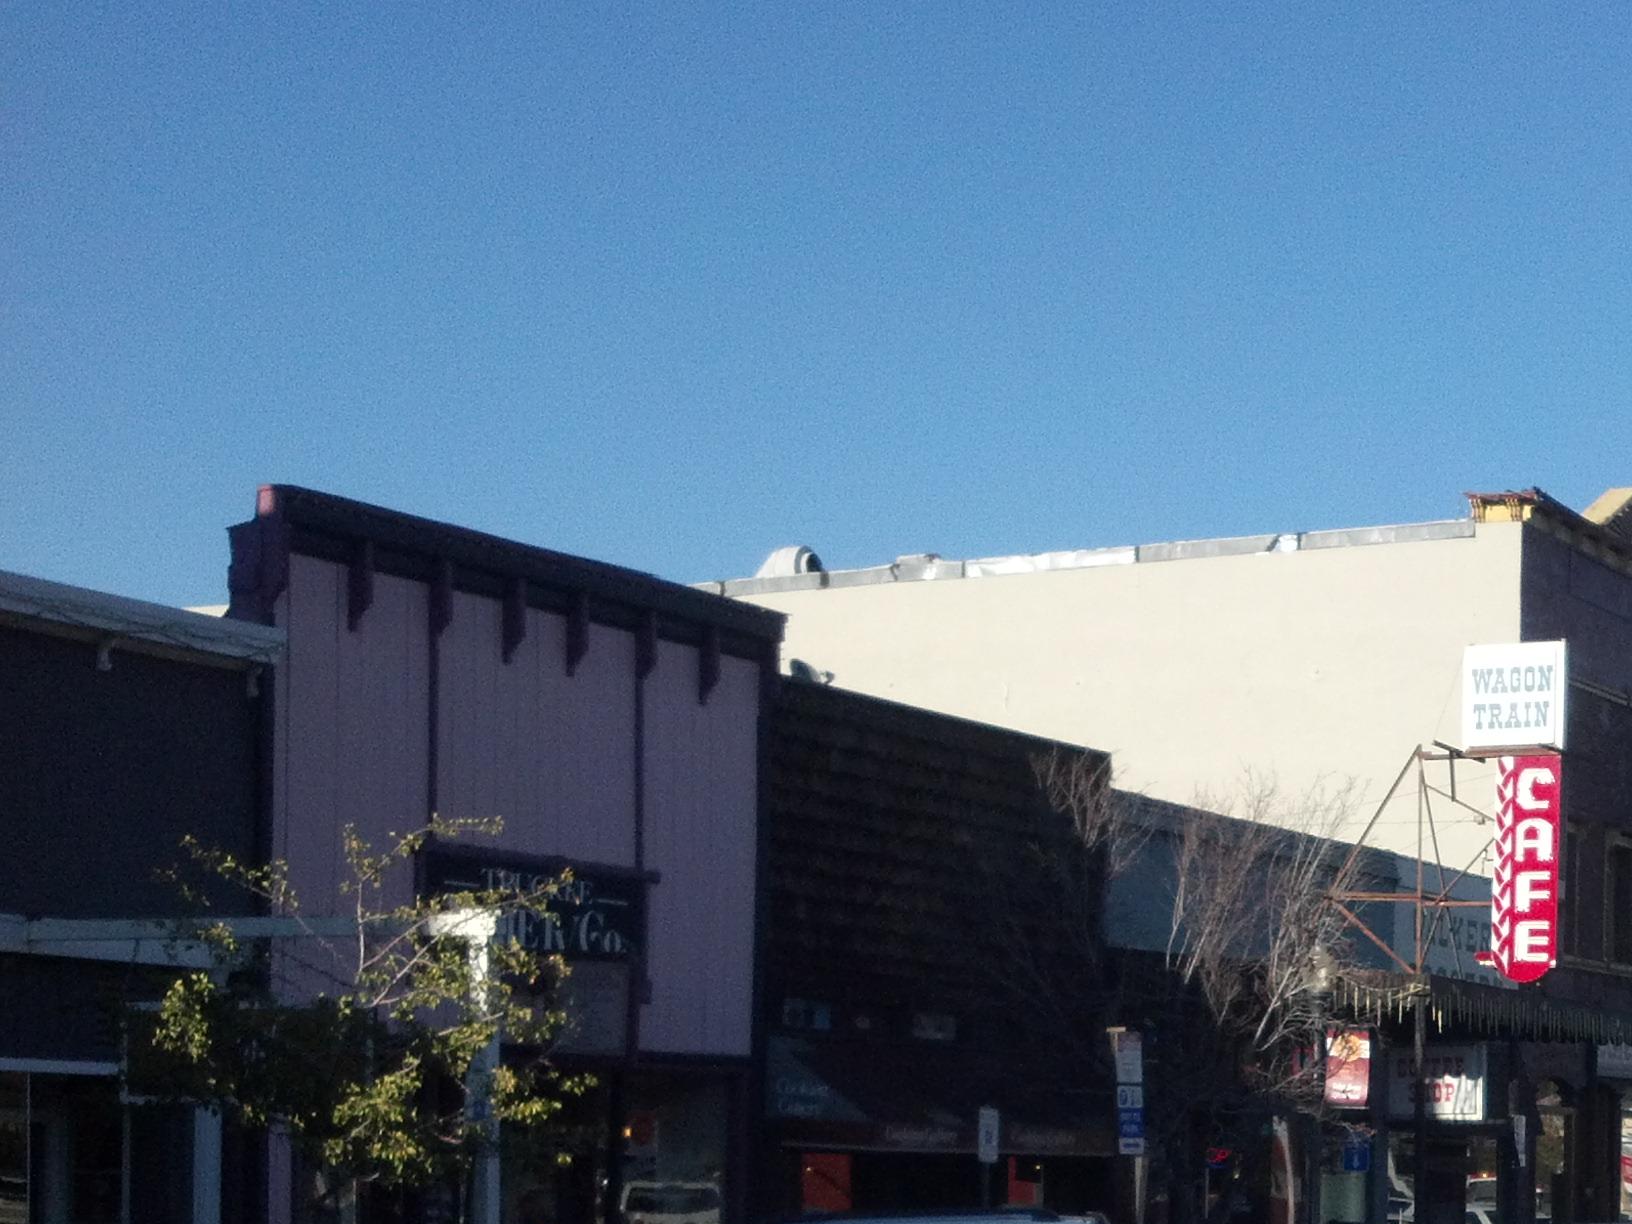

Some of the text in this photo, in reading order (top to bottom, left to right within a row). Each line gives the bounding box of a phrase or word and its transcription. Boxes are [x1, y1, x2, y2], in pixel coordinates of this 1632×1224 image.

[1472, 665, 1553, 694] WAGON
[1473, 700, 1549, 729] TRAIN
[1513, 767, 1556, 963] CAFE
[1397, 1056, 1464, 1078] COFEE
